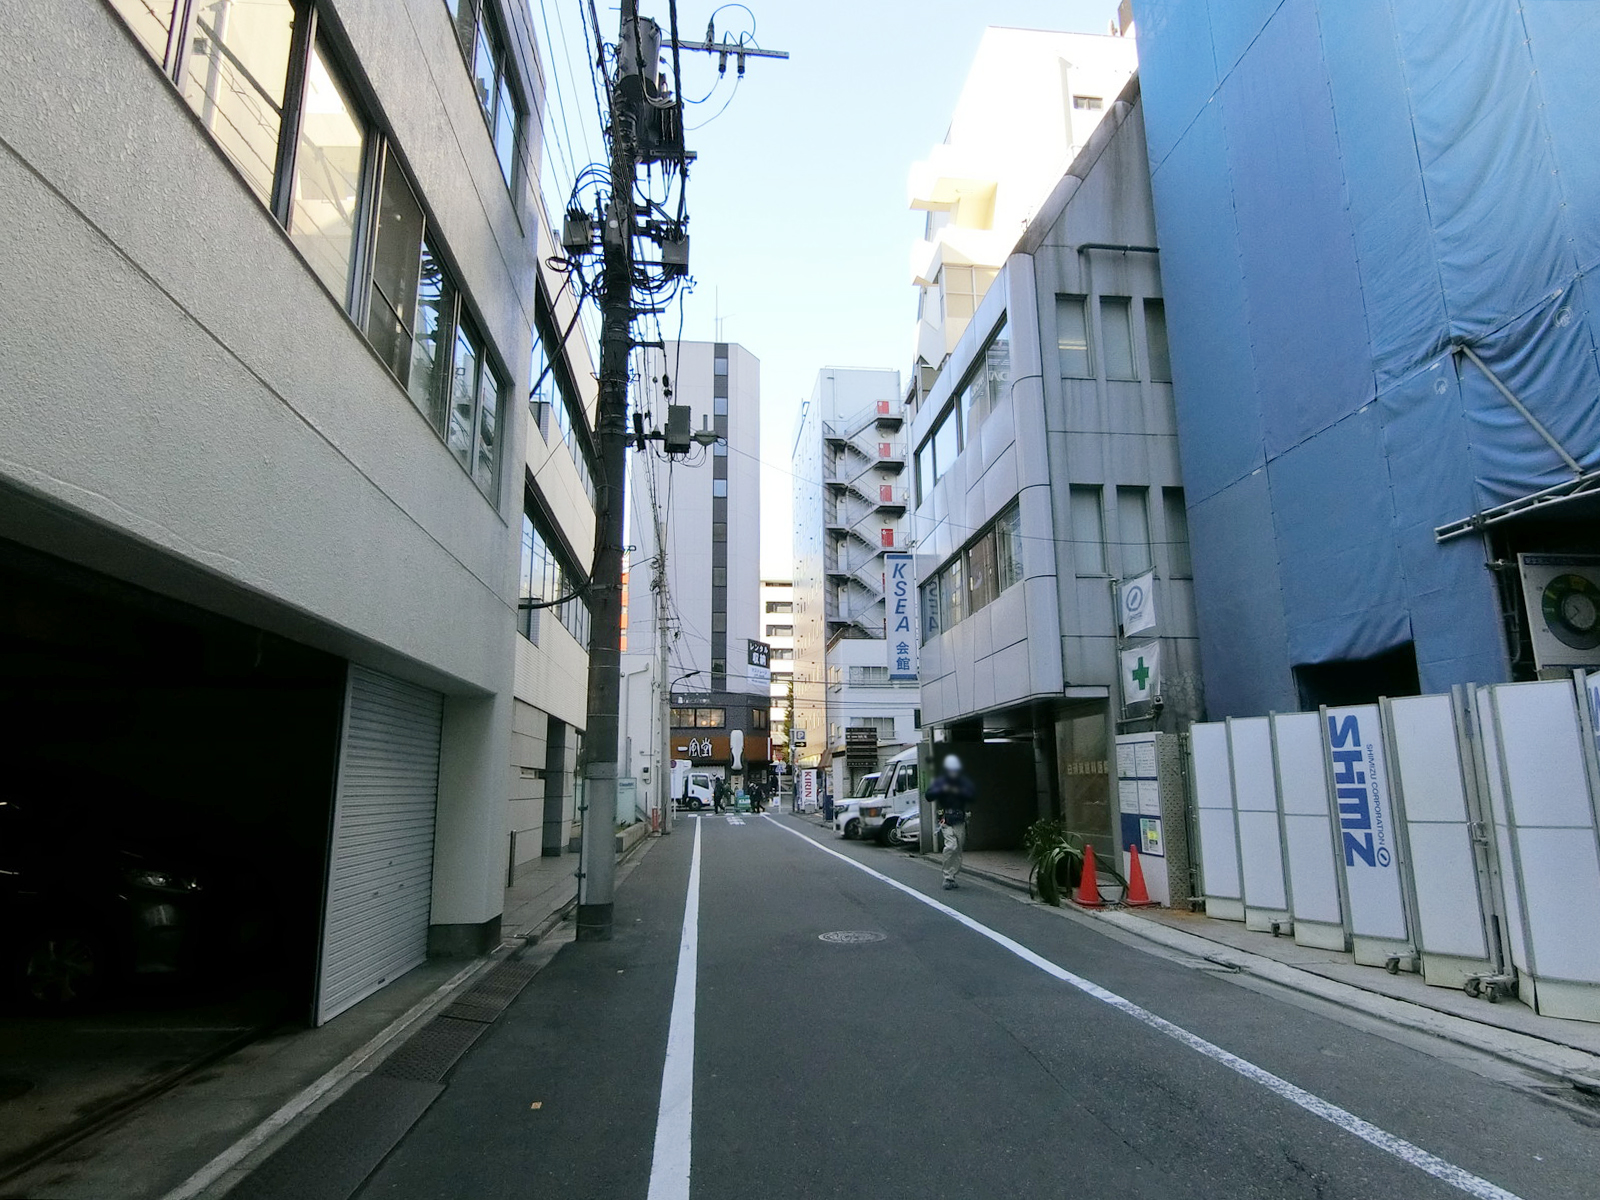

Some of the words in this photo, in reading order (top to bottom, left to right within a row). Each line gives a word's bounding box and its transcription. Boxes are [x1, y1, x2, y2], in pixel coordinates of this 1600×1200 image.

[892, 563, 910, 632] KSEA
[749, 642, 769, 654] レンタル
[896, 641, 911, 671] 会館
[677, 737, 712, 757] 一風堂
[804, 771, 812, 798] KIRIN
[1366, 743, 1376, 780] SHIMIZU
[1371, 781, 1386, 845] CORPORATION
